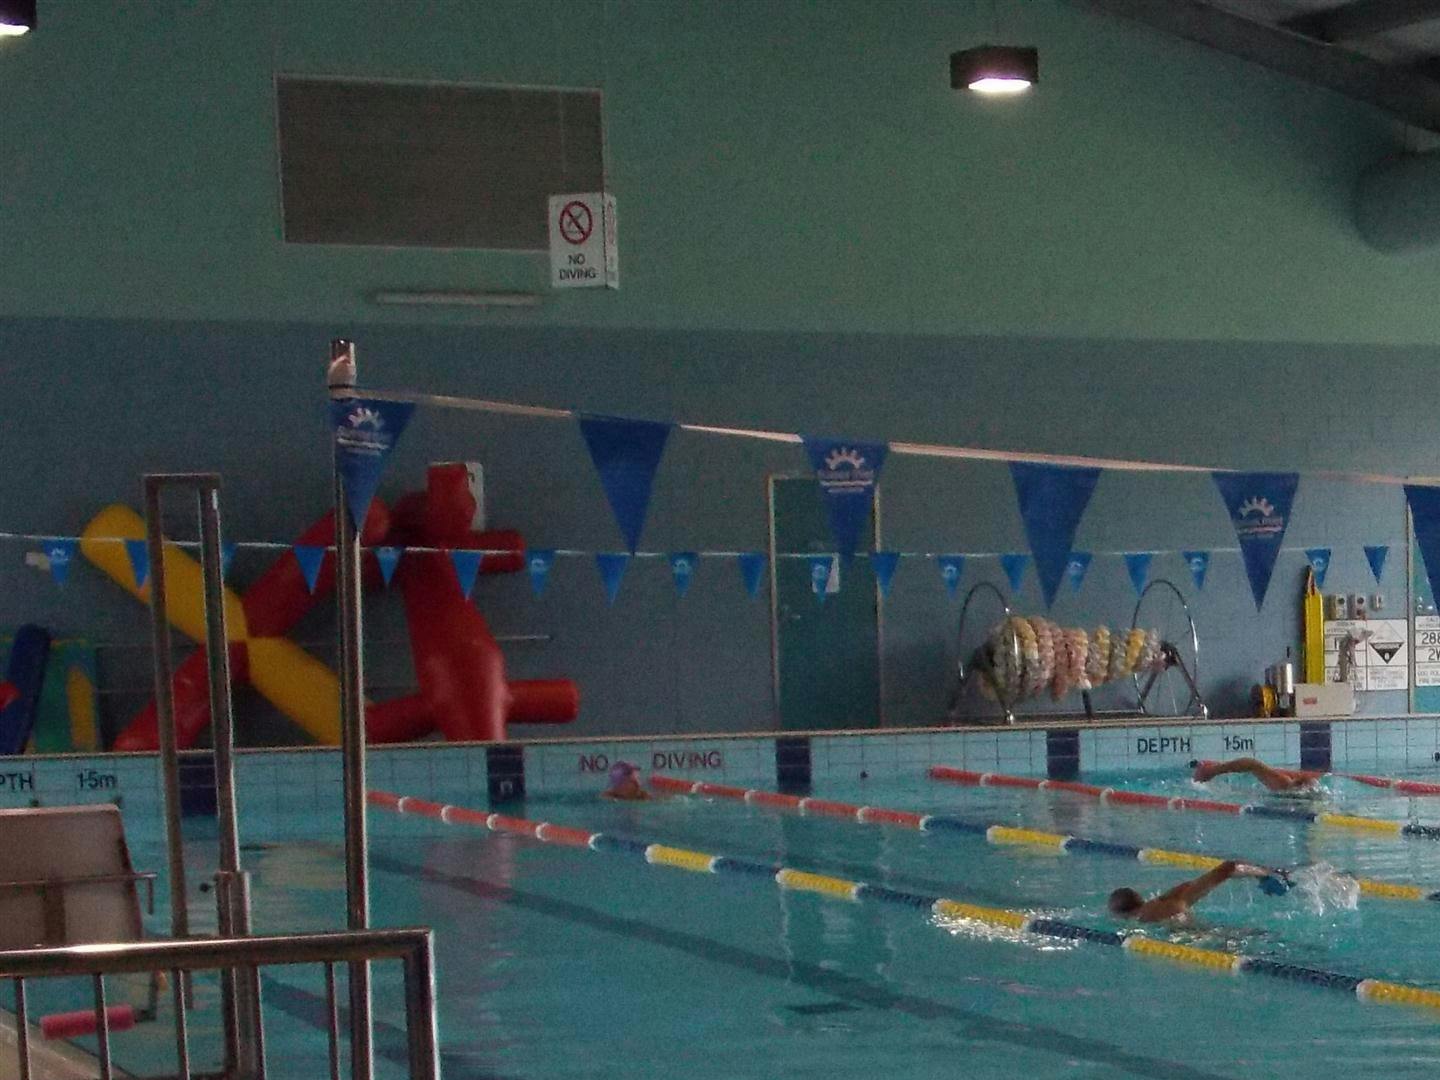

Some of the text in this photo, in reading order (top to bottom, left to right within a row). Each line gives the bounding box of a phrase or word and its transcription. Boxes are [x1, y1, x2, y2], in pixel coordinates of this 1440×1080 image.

[568, 253, 586, 265] NO
[559, 267, 597, 280] DIVING
[1137, 737, 1191, 753] DEPTH
[580, 751, 722, 772] NO DIVING
